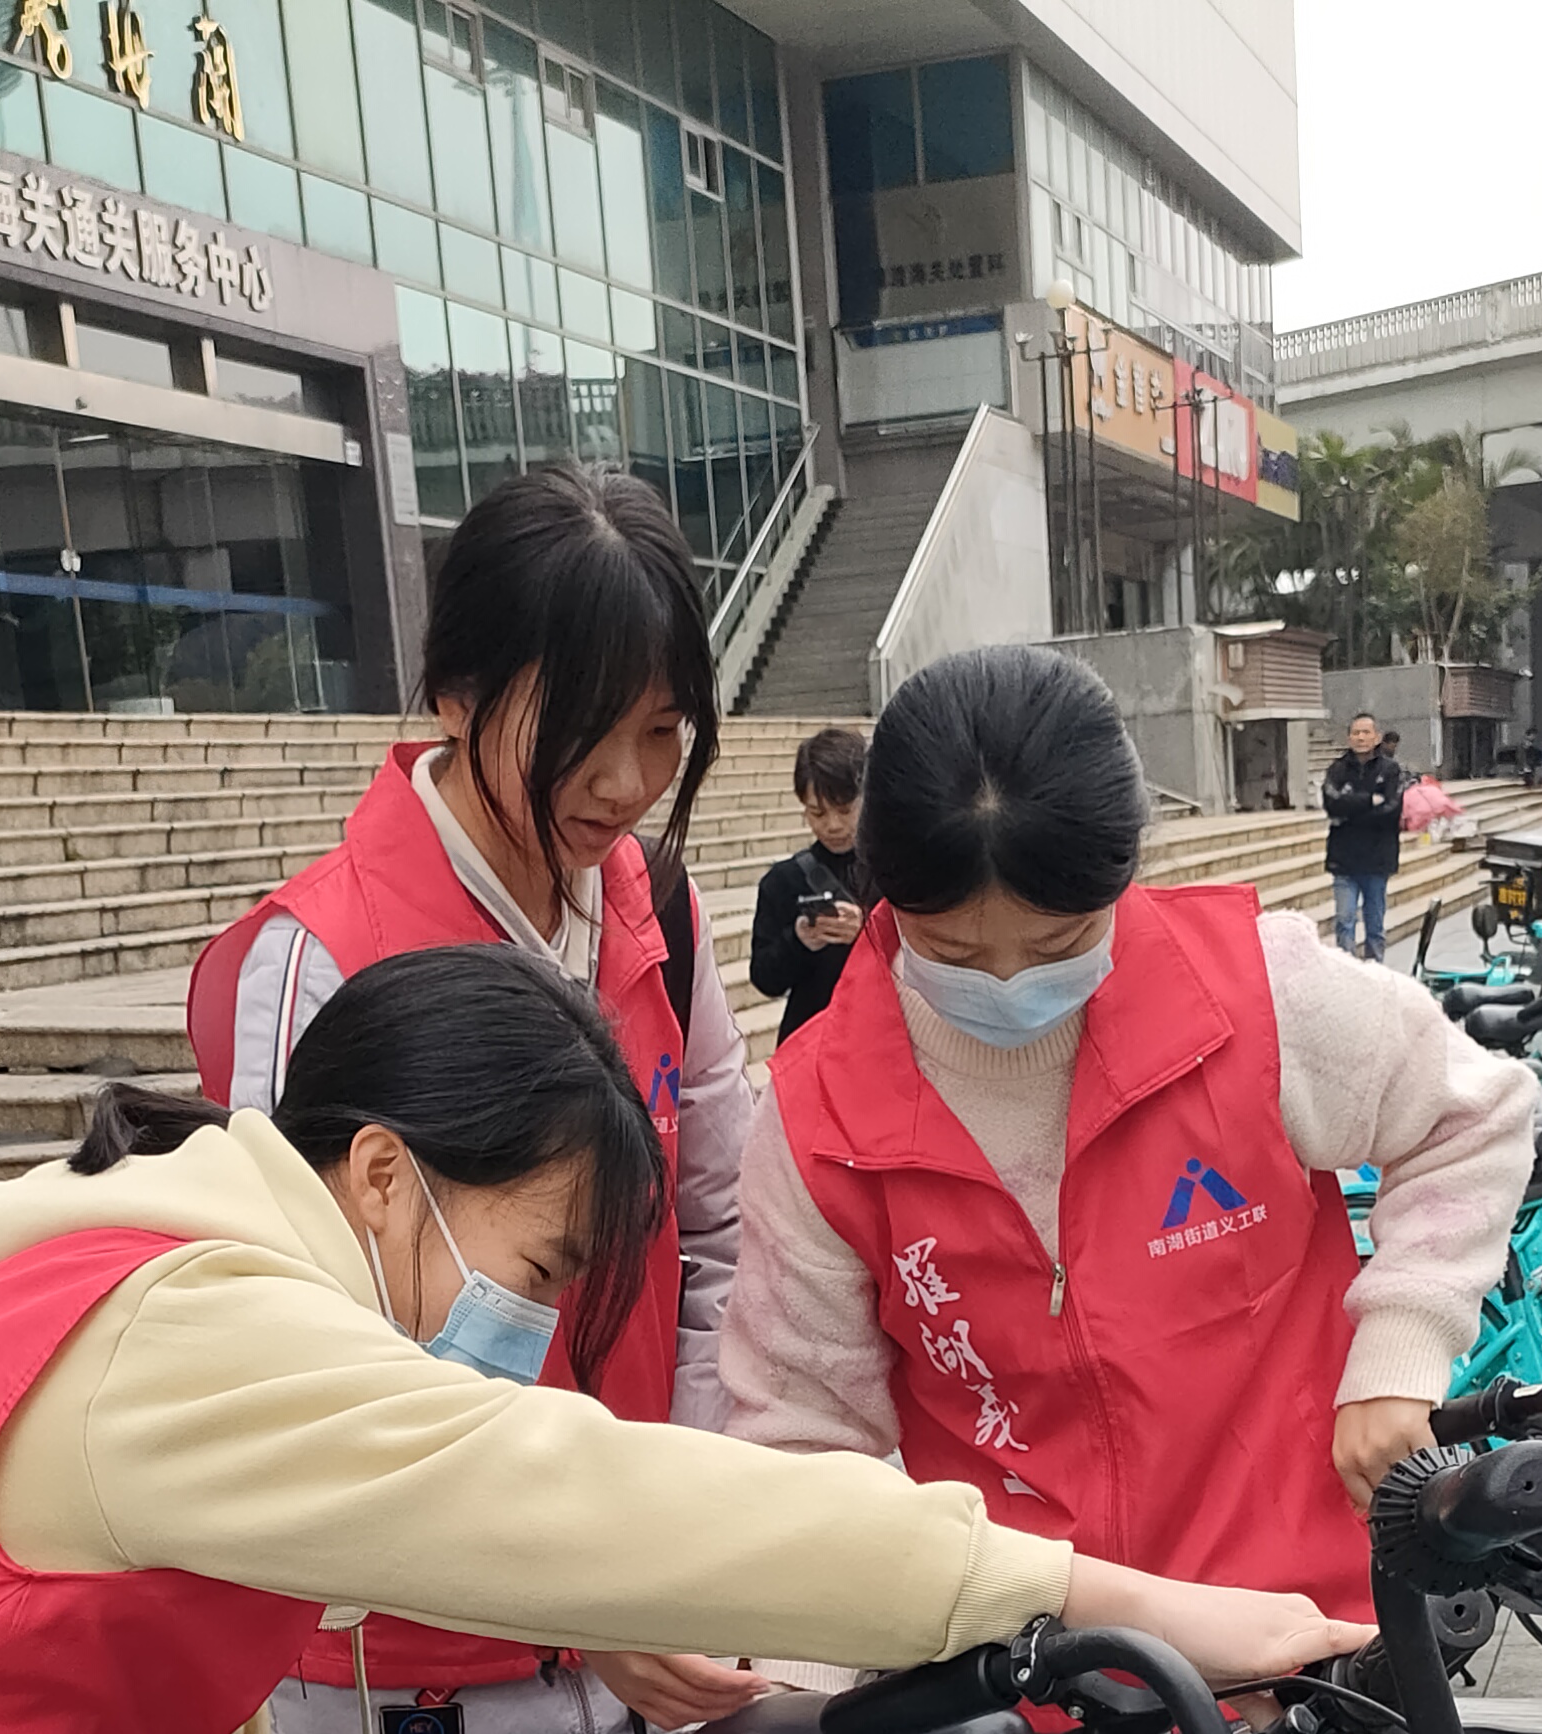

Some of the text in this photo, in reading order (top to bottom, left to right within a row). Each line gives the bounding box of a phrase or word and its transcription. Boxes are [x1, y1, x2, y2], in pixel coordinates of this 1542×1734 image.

[1147, 1203, 1268, 1259] 南湖街道义工联
[409, 1721, 434, 1734] HEY
